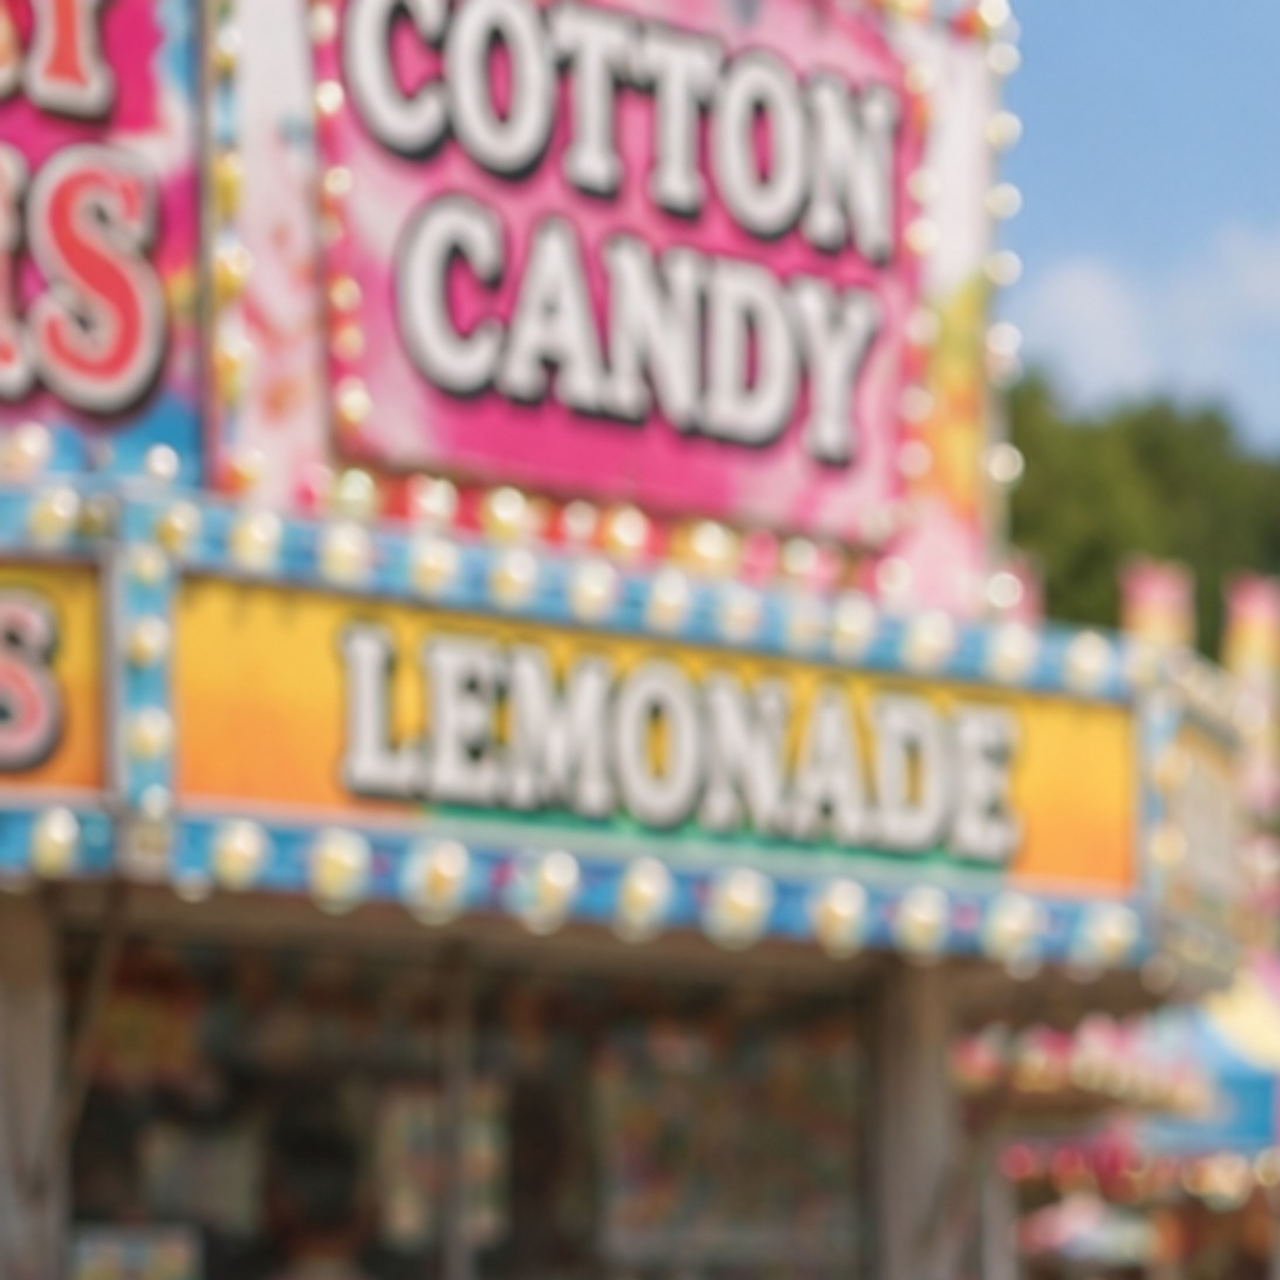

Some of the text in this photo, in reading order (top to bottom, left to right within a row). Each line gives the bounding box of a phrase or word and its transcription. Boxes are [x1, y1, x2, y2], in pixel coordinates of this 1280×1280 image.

[343, 0, 900, 264] COTTON
[401, 194, 880, 464] CANDY
[342, 625, 1020, 862] LEMONADE
